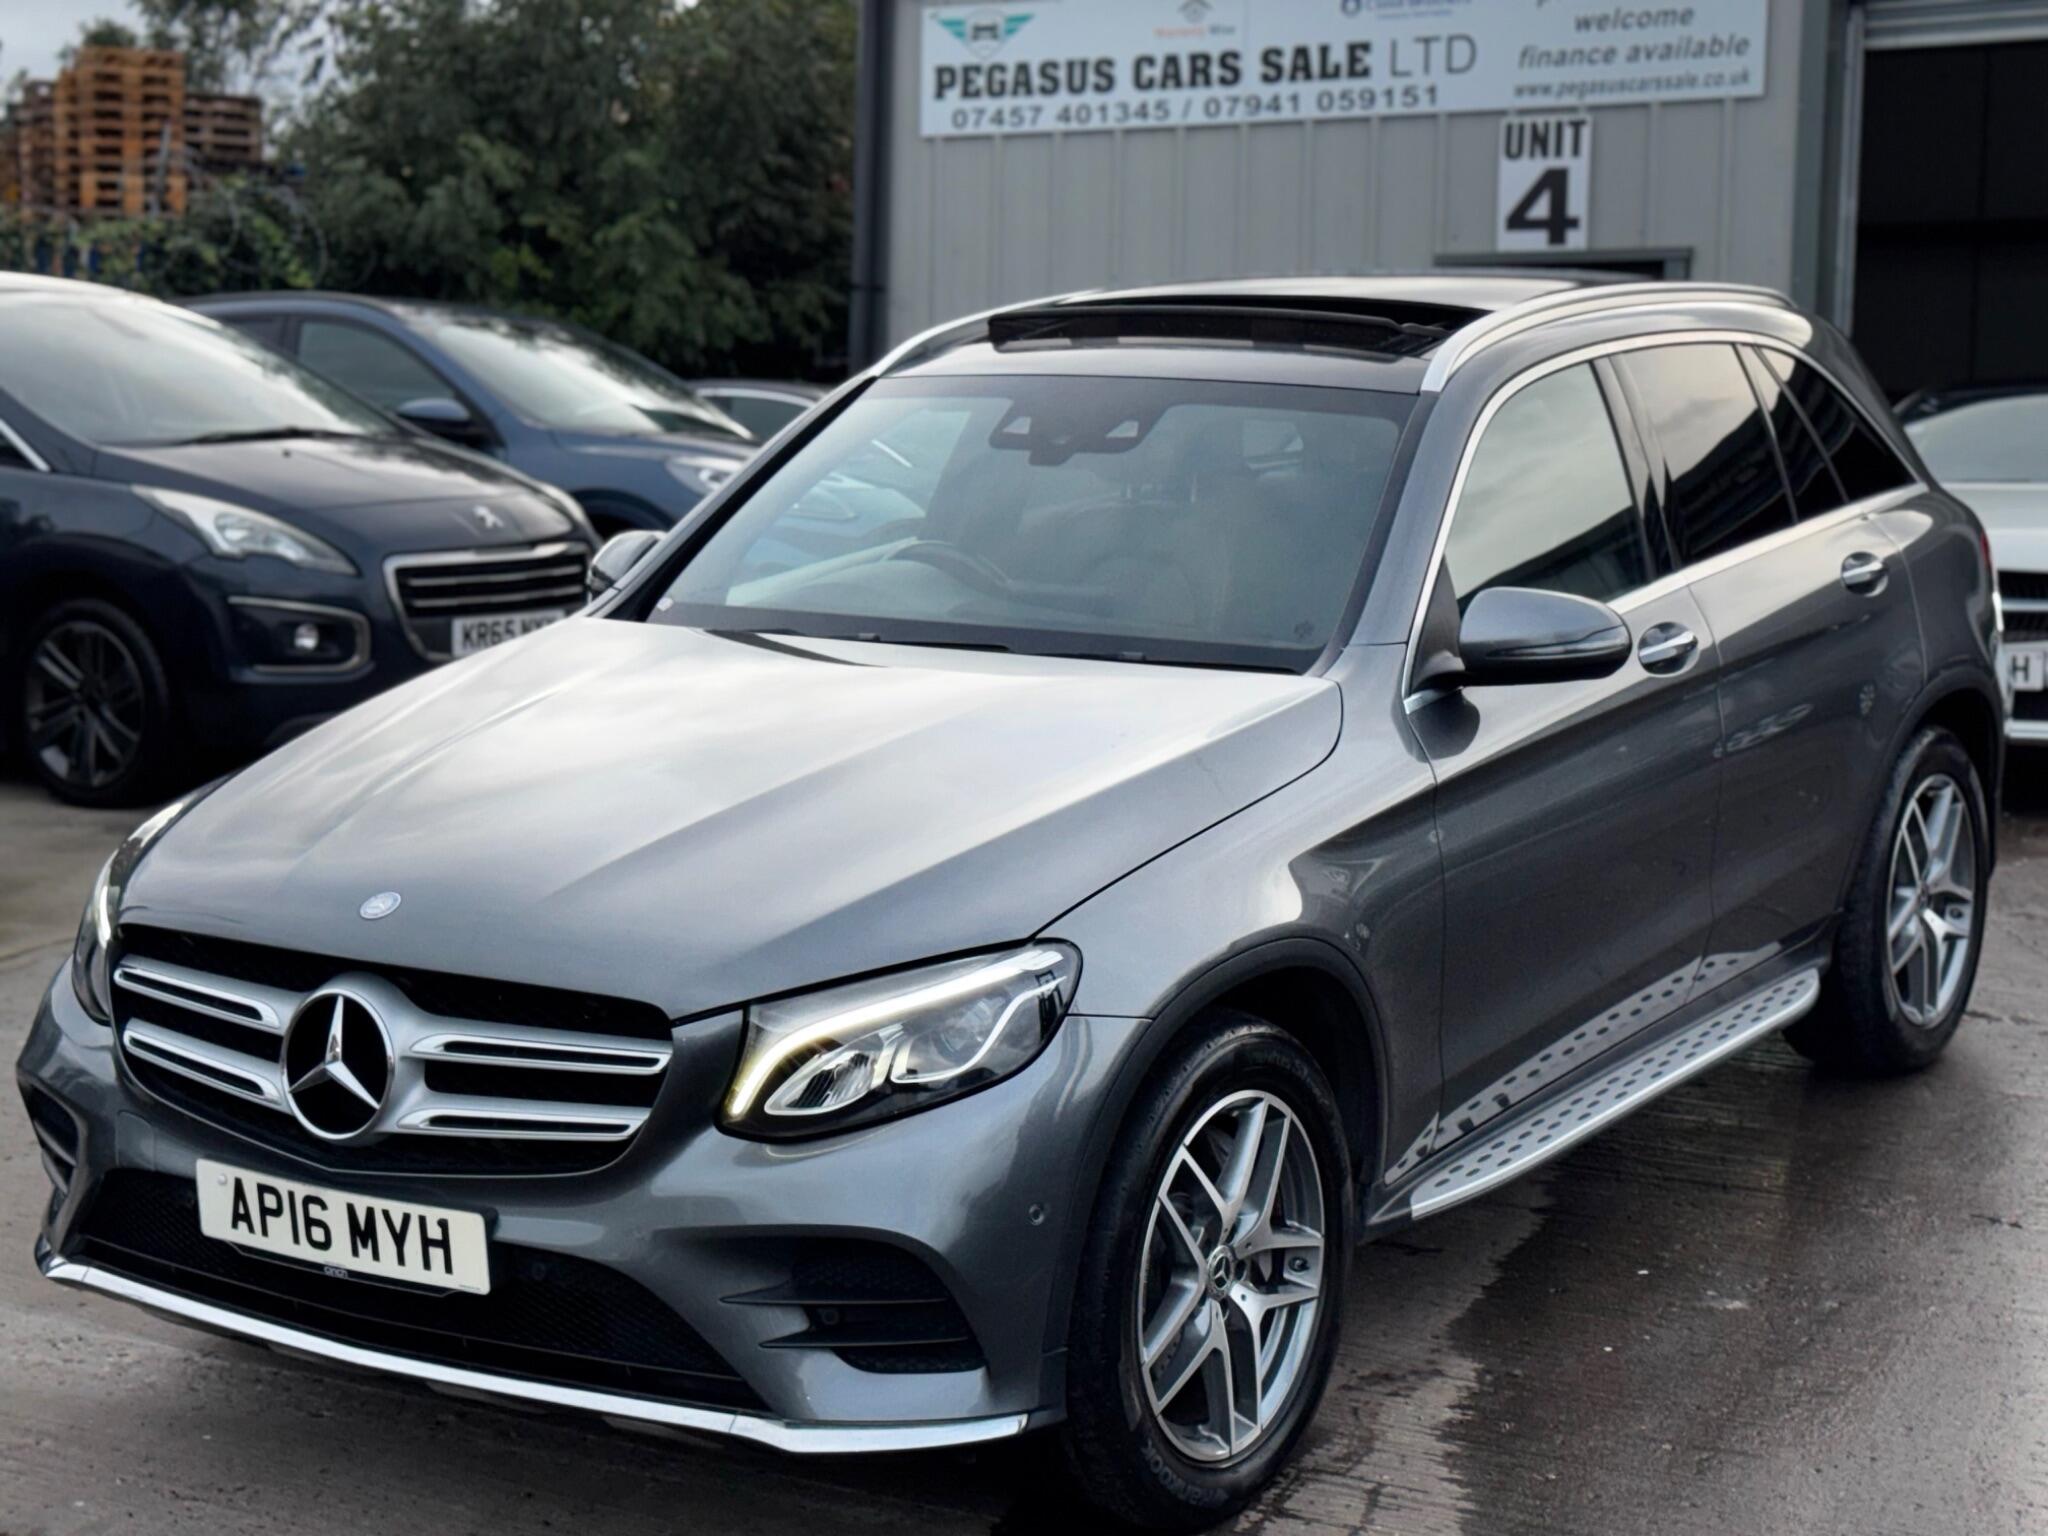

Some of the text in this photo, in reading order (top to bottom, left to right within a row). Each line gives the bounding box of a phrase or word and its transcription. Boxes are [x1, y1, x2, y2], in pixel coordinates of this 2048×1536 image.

[1574, 7, 1695, 32] welcome
[934, 33, 1477, 100] PEGASUS CARS SALE LTD
[1518, 34, 1749, 70] finance available
[952, 107, 1043, 129] 07457
[1056, 101, 1171, 126] 401345
[1204, 94, 1300, 117] 07941
[1316, 86, 1438, 112] 059151
[1505, 119, 1587, 160] UNIT
[1506, 168, 1580, 245] 4
[462, 619, 515, 648] KR65
[231, 1177, 453, 1275] AP16 MYH
